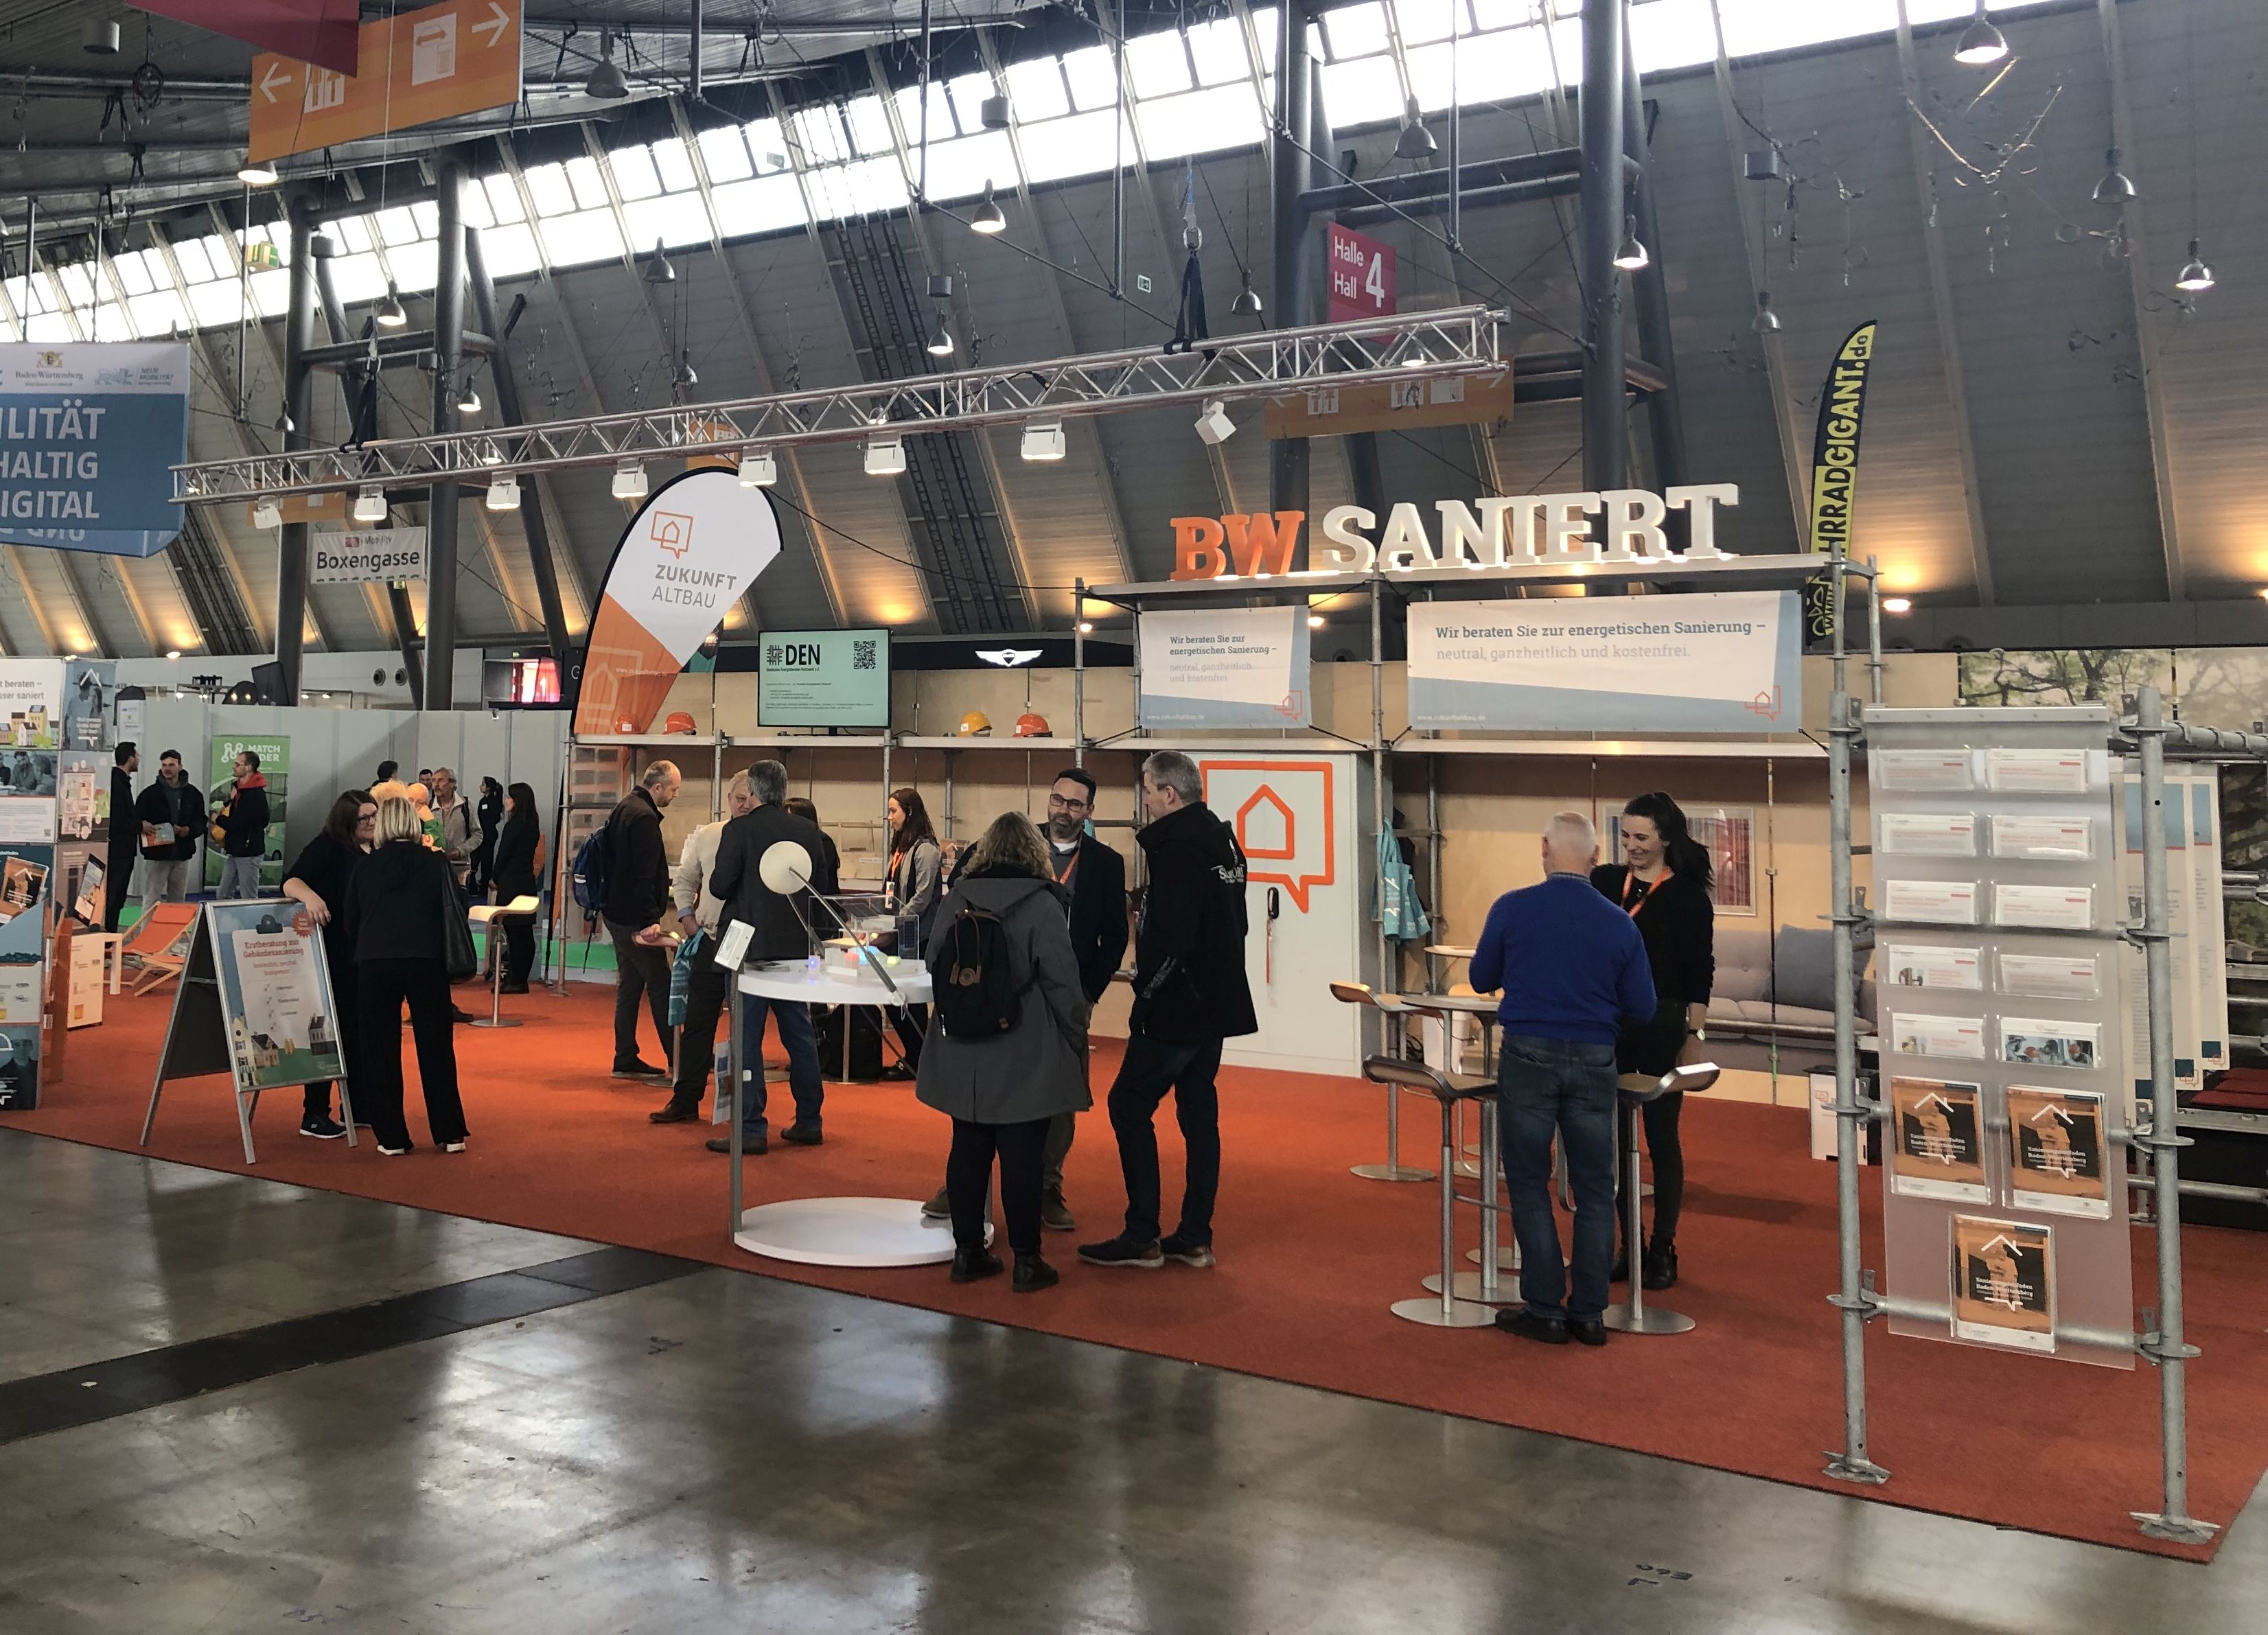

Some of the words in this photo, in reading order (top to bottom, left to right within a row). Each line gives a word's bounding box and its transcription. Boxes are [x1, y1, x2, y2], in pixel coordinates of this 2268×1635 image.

[1334, 235, 1364, 267] Halle
[1334, 271, 1356, 299] Hall
[1365, 252, 1385, 308] 4
[1170, 510, 1305, 581] BW
[1321, 483, 1739, 571] SANIERT
[316, 551, 420, 572] Boxengasse
[655, 564, 737, 590] ZUKUNFT
[651, 585, 716, 608] ALTBAU
[1436, 627, 1459, 638] Wir
[1463, 626, 1513, 638] beraten
[1517, 625, 1538, 637] Sie
[1542, 627, 1564, 636] zur
[1569, 622, 1670, 638] energetischen
[1674, 621, 1751, 635] Sanierung
[1186, 636, 1216, 644] beraten
[785, 644, 820, 665] DEN
[1170, 647, 1226, 656] energetischen
[1227, 646, 1269, 655] Sanierung
[1437, 647, 1487, 660] neutral,
[1490, 645, 1577, 662] ganzheitlich
[1582, 645, 1608, 658] und
[1613, 644, 1691, 658] kostenfrei.
[1201, 662, 1252, 672] ganzheitlich
[1170, 675, 1185, 683] und
[17, 692, 45, 700] saniert
[248, 744, 281, 753] MATCH
